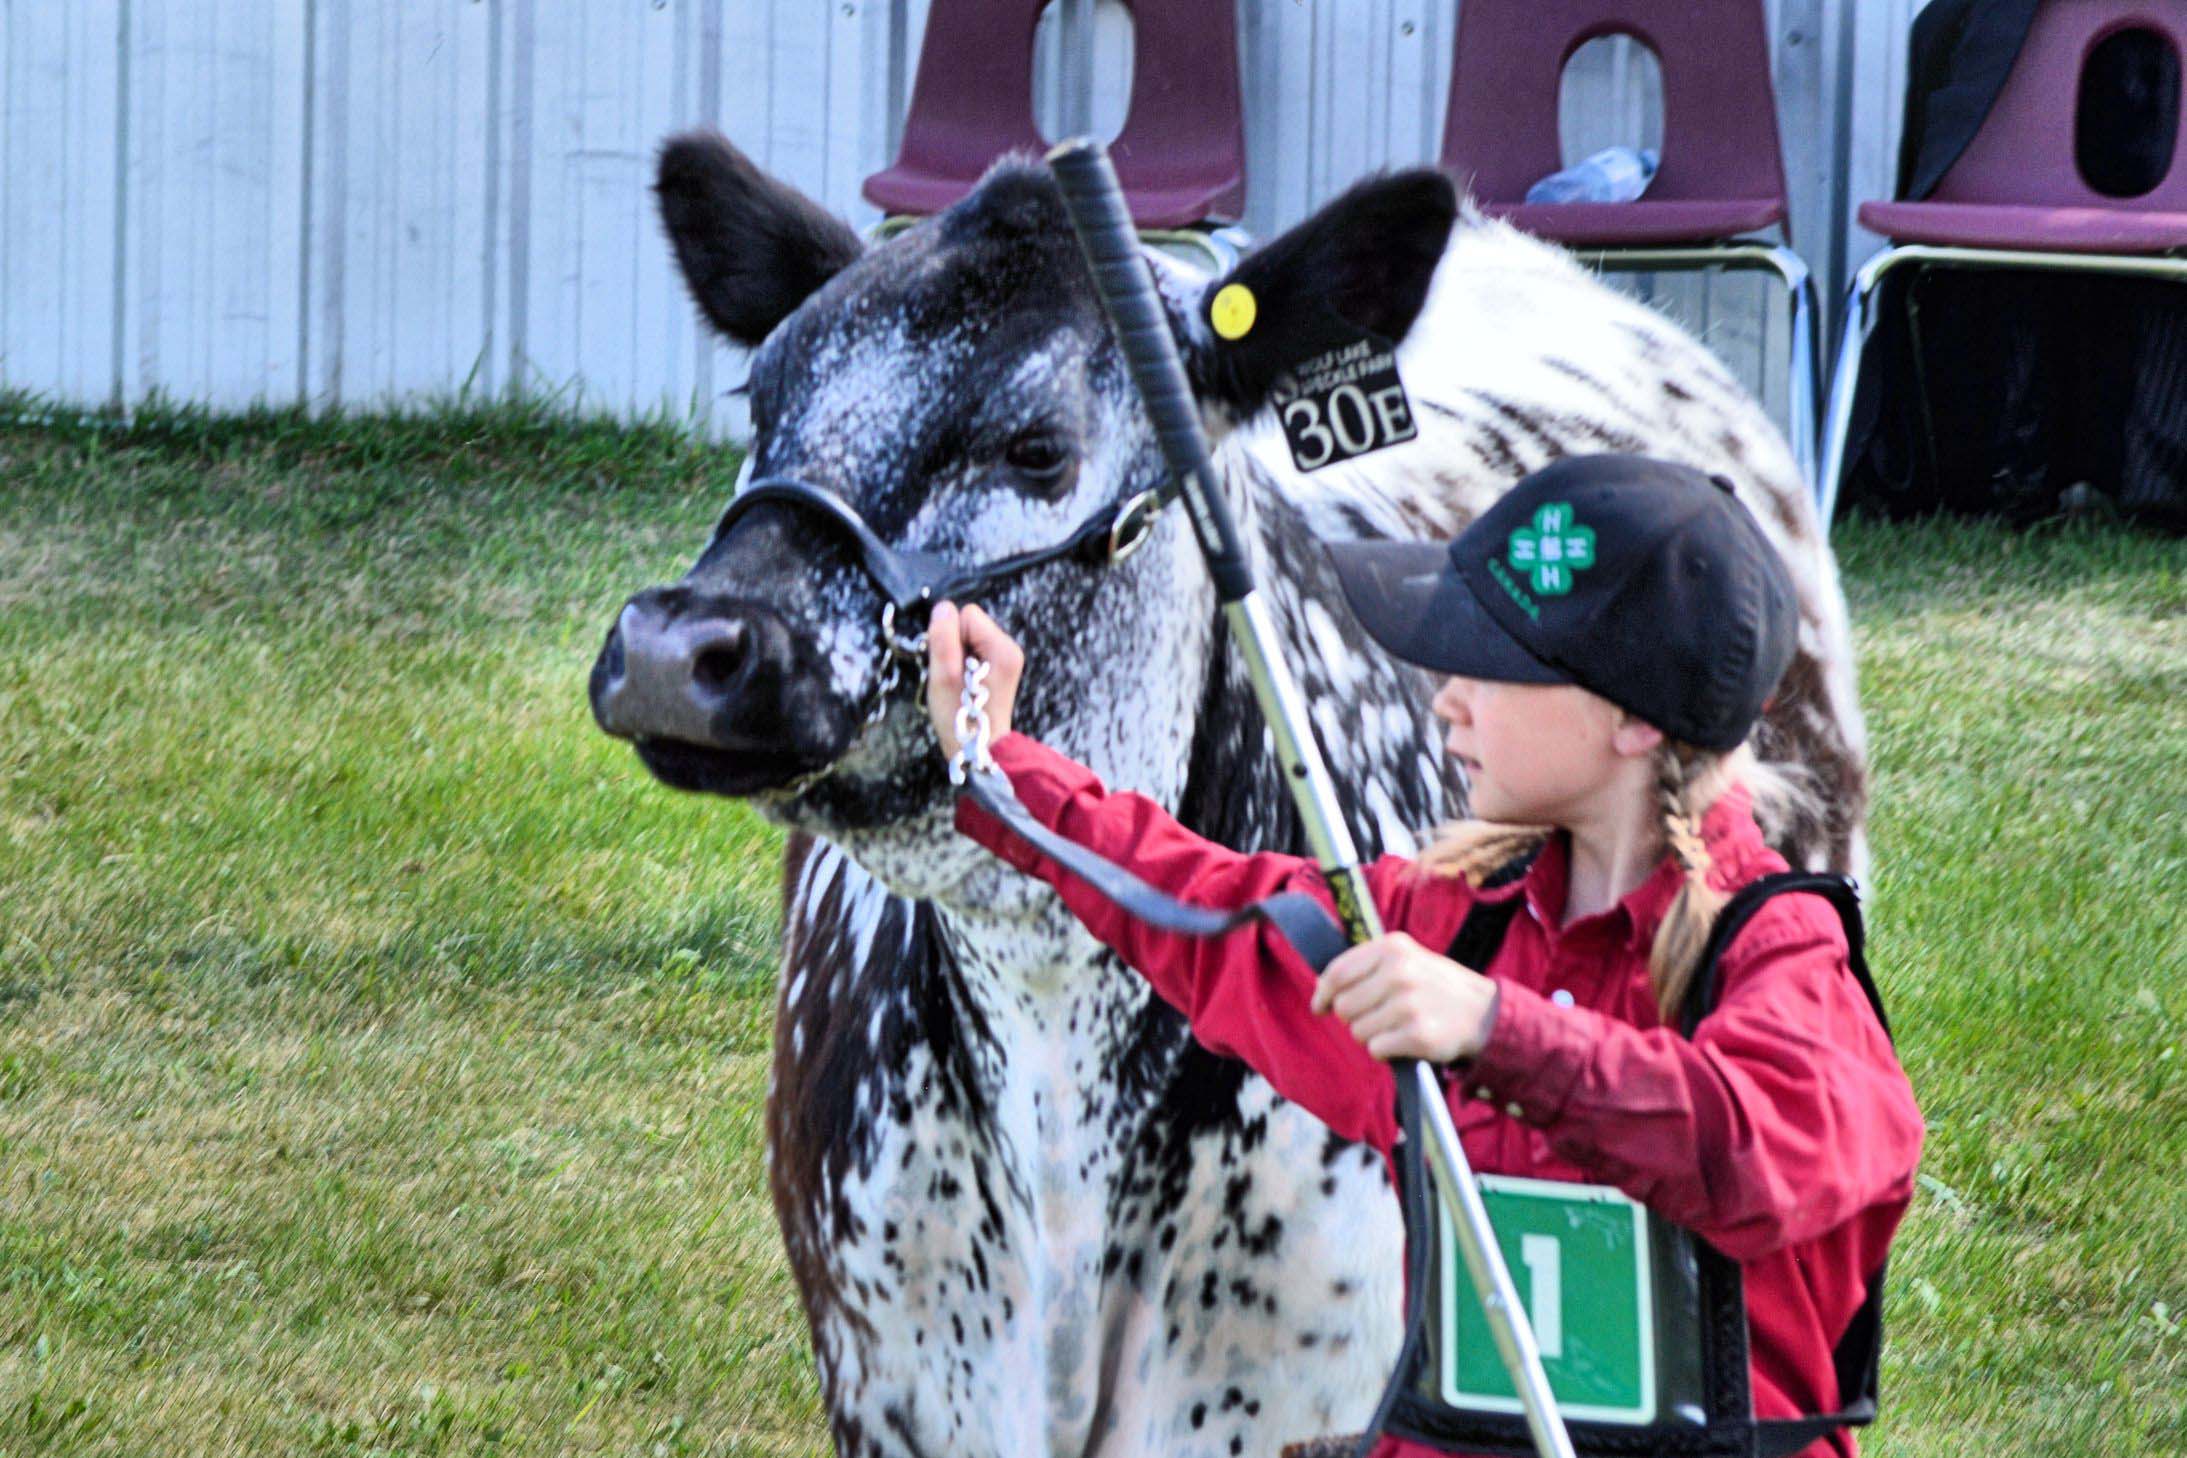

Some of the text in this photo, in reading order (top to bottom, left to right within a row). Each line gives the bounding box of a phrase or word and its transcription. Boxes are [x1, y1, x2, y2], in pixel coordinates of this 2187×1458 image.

[1336, 339, 1371, 367] LAKE
[1284, 384, 1417, 471] 30E
[1542, 508, 1561, 533] H
[1541, 565, 1560, 590] H
[1522, 1234, 1562, 1358] 1
